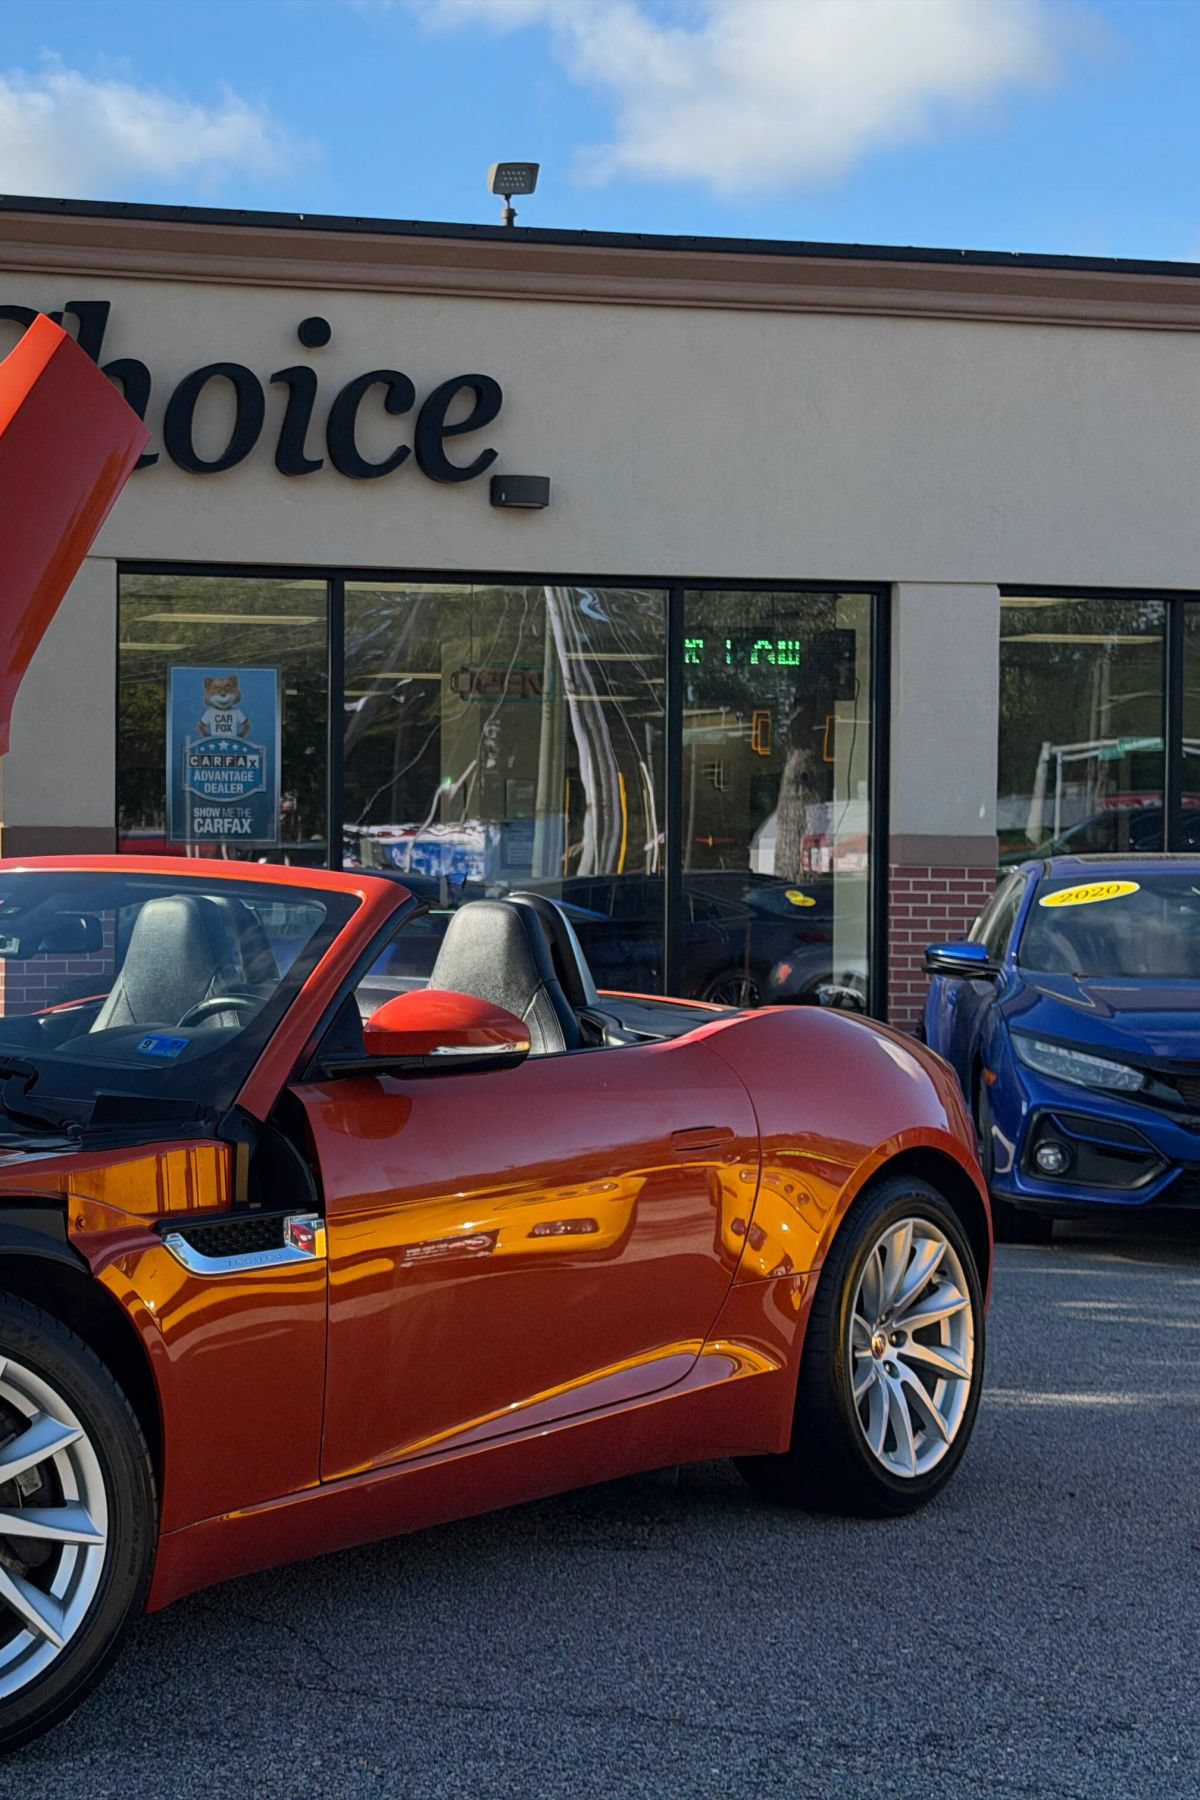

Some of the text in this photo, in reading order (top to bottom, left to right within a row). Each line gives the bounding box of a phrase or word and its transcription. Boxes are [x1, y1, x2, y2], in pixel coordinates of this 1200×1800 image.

[214, 714, 233, 723] CAR
[215, 724, 233, 733] FOX
[189, 756, 258, 768] CARFAX
[194, 770, 254, 782] ADVANTAGE
[204, 783, 244, 794] DEALER
[193, 807, 252, 818] SHOW ME THE
[193, 818, 252, 834] CARFAX
[1058, 884, 1121, 904] 2020
